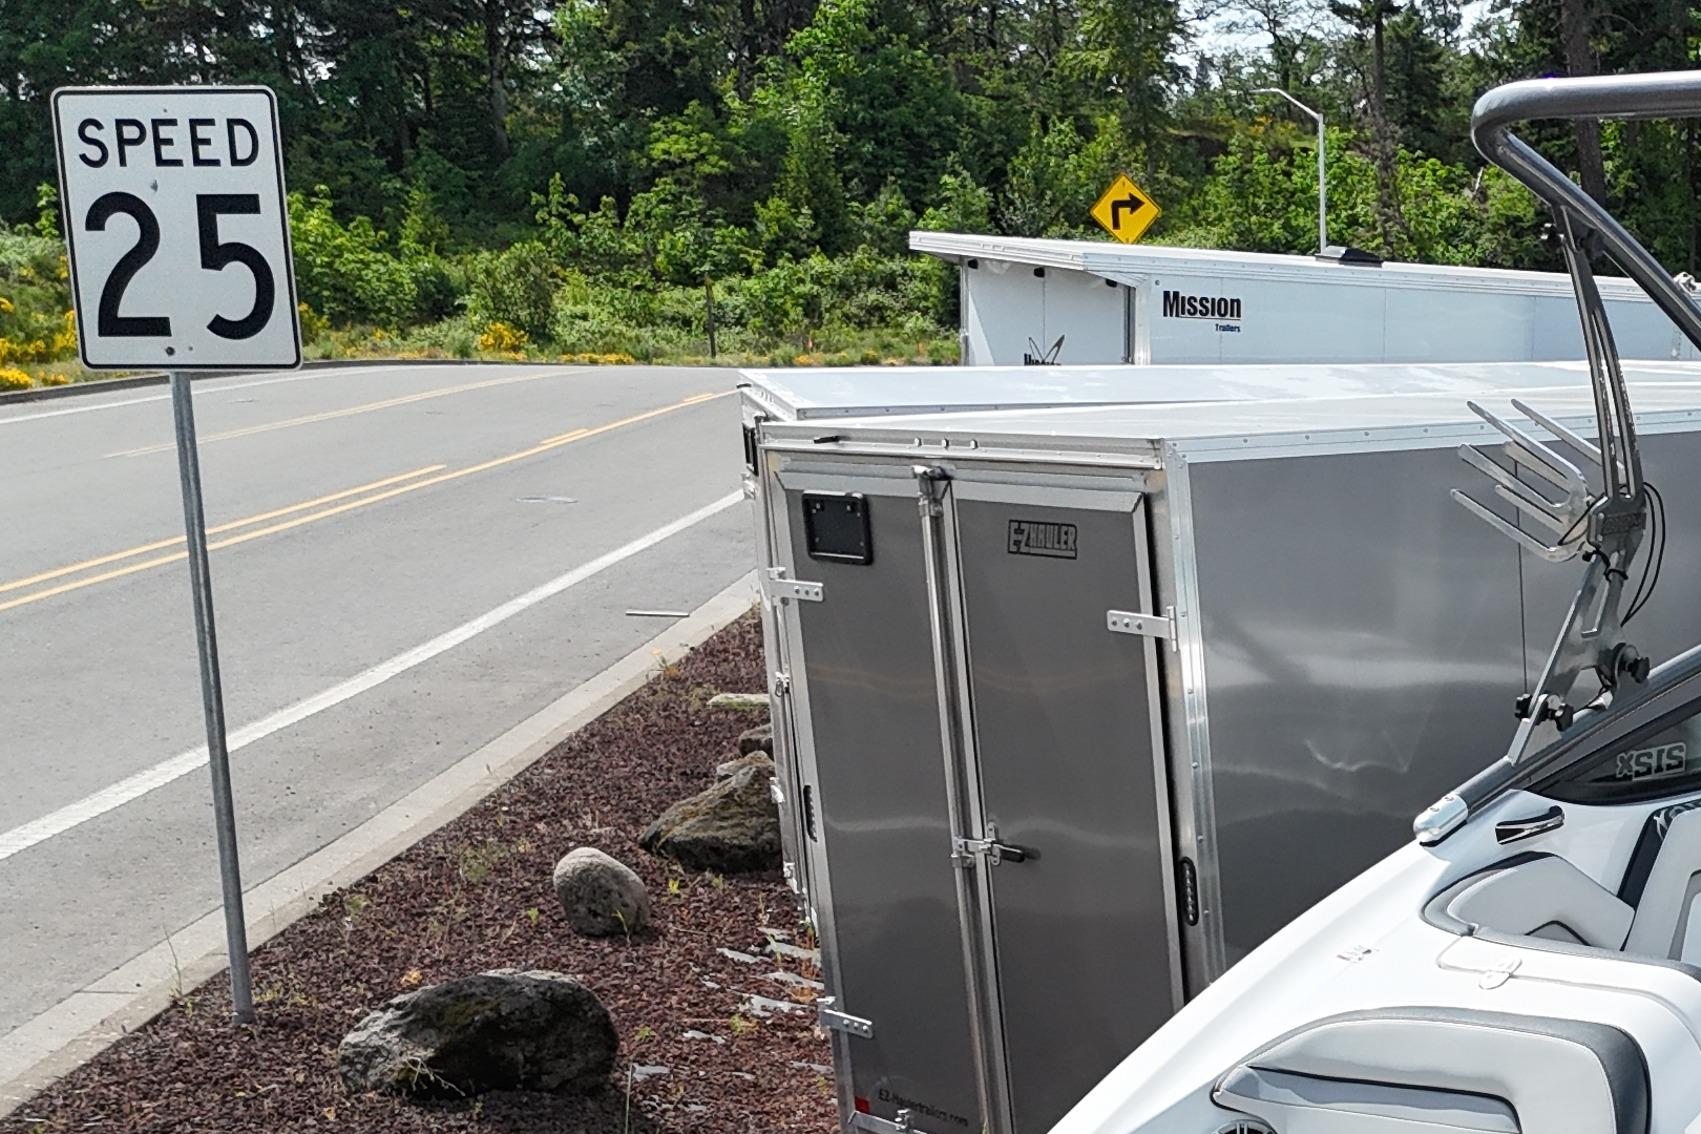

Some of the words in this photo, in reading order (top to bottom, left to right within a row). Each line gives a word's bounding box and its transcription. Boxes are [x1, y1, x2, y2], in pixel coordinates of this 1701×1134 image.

[78, 117, 259, 169] SPEED
[84, 191, 275, 340] 25
[1163, 290, 1242, 318] Mission
[1215, 323, 1241, 333] Trailers
